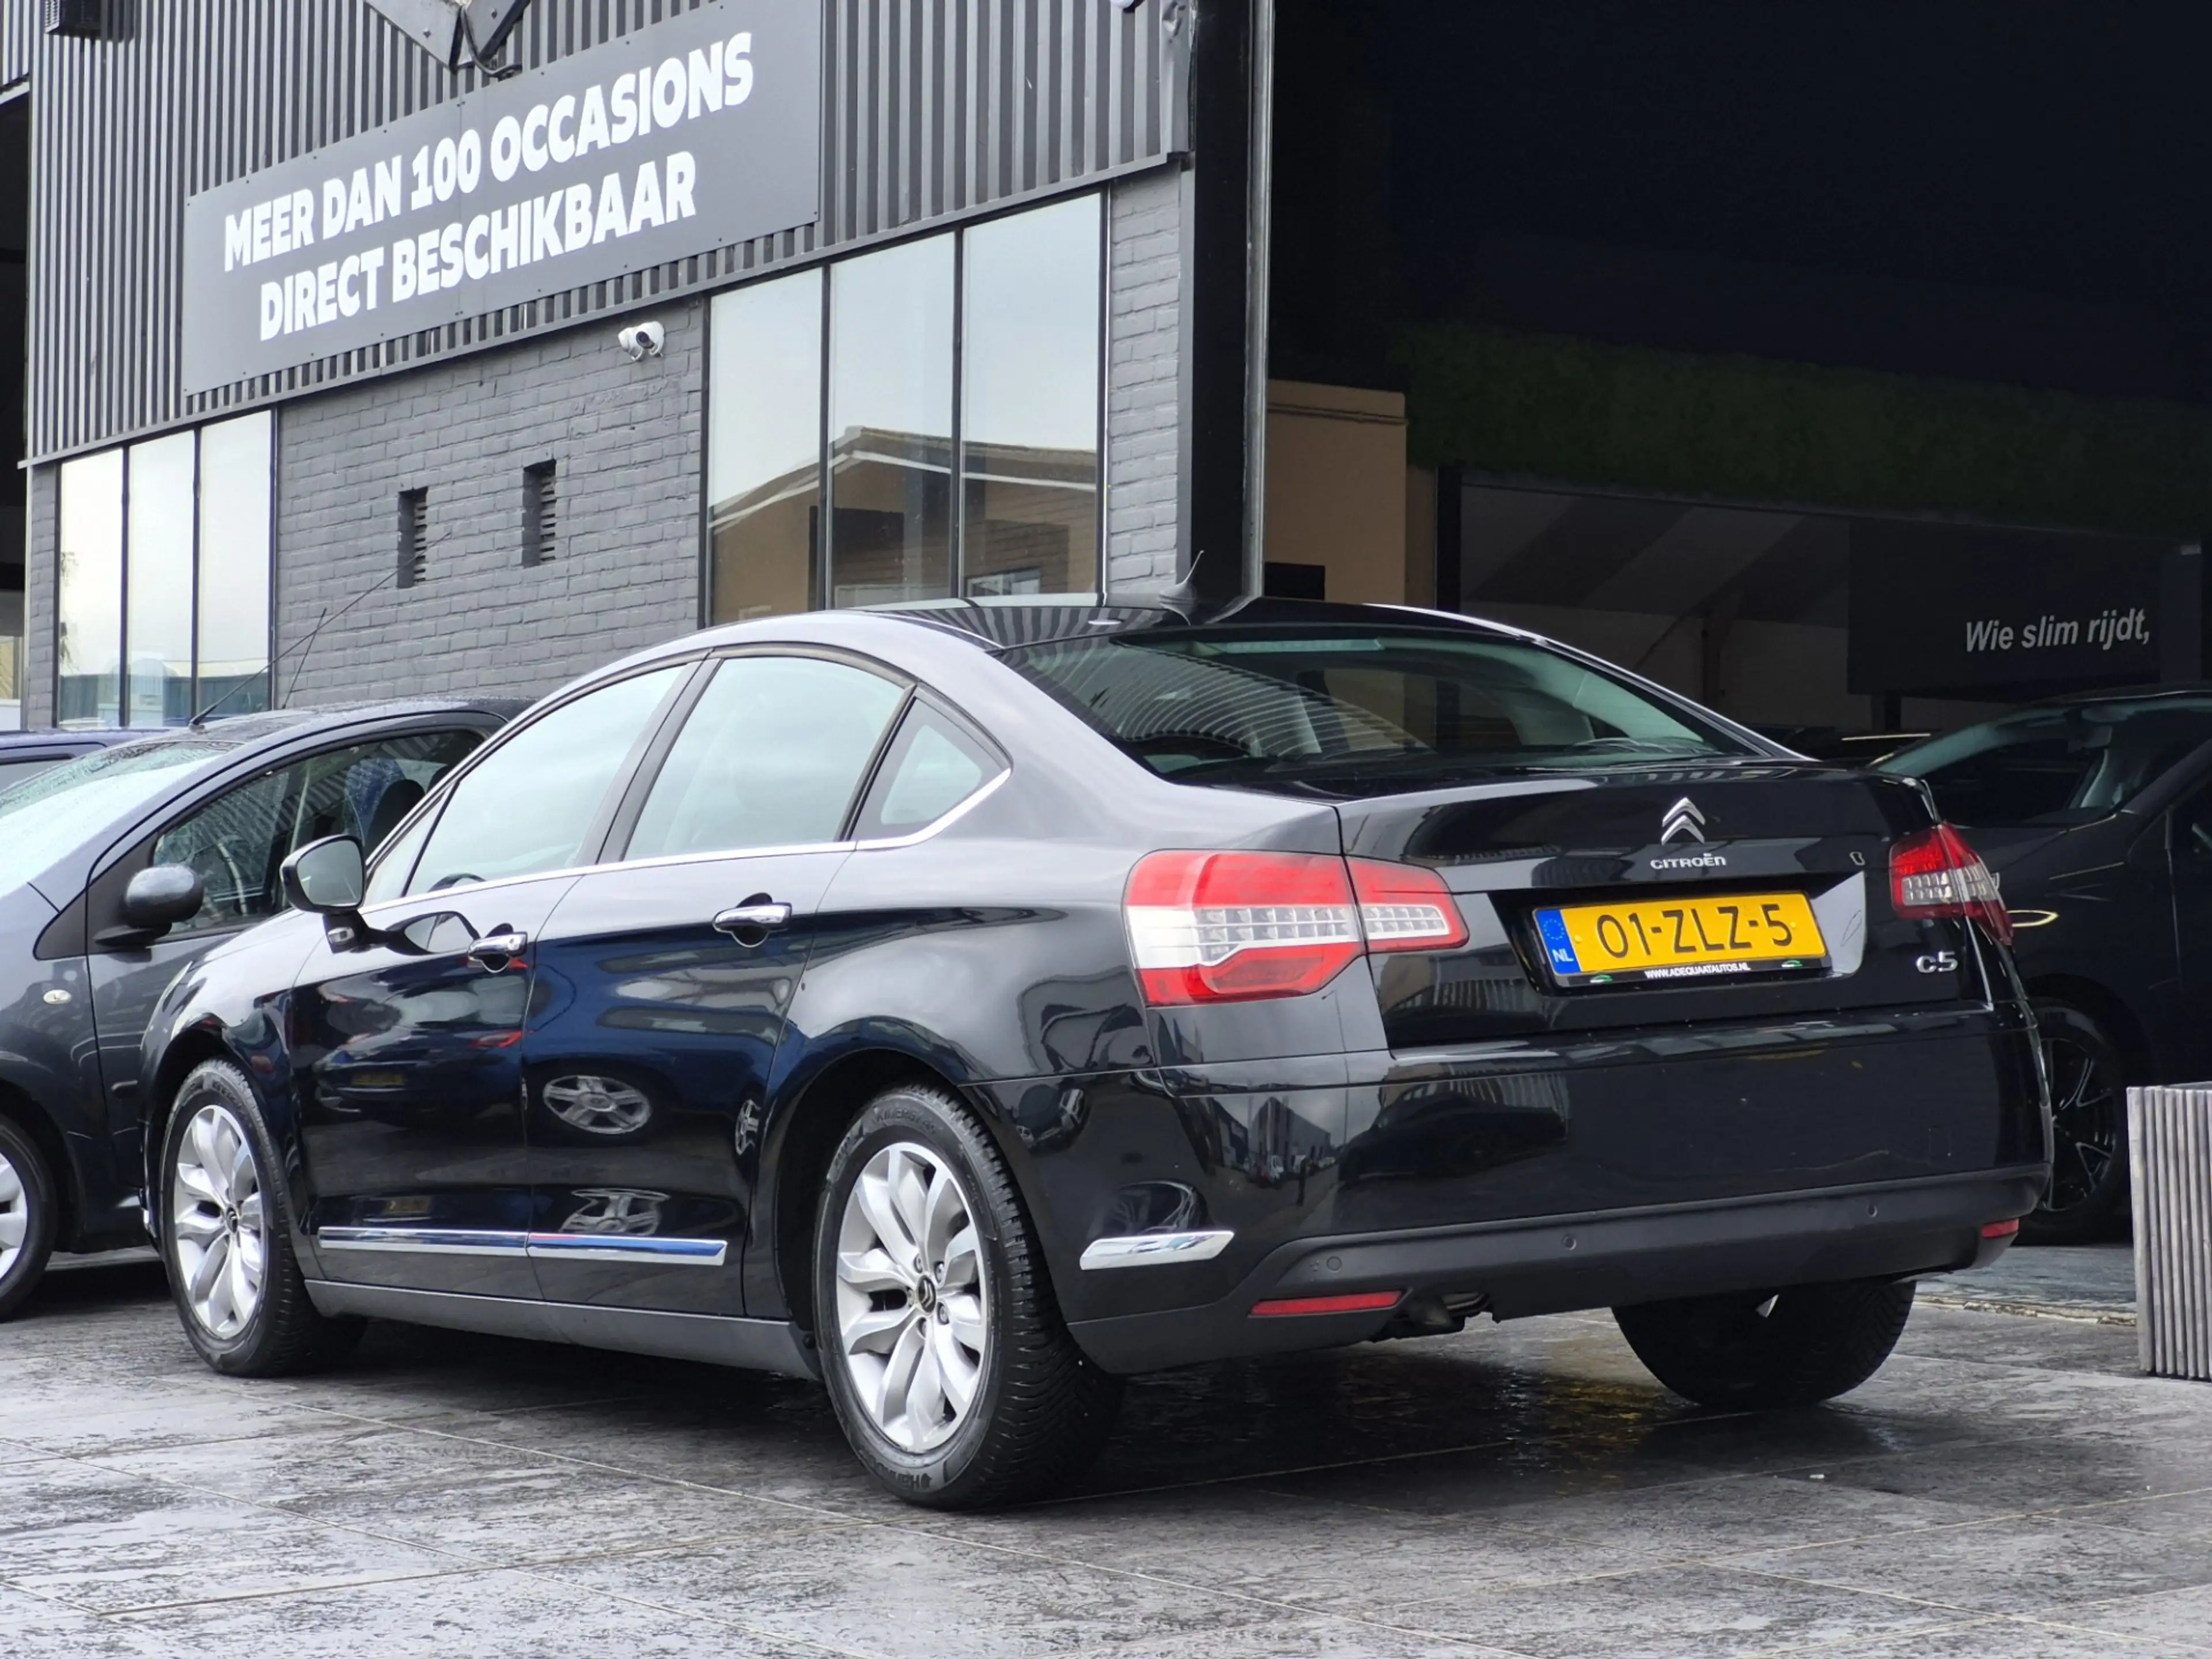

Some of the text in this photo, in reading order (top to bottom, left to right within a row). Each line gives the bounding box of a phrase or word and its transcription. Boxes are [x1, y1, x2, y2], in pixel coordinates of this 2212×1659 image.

[225, 32, 753, 272] MEER DAN 100 OCCASIONS
[260, 151, 695, 341] DIRECT BESCHIKBAAR
[1966, 608, 2150, 652] Wie slim rijdt,
[1596, 903, 1793, 959] 01-ZLZ-5
[1552, 948, 1574, 963] NL
[1644, 961, 1751, 979] WWW.ADEQUAATAUTOS.NL
[1915, 950, 1959, 974] C5
